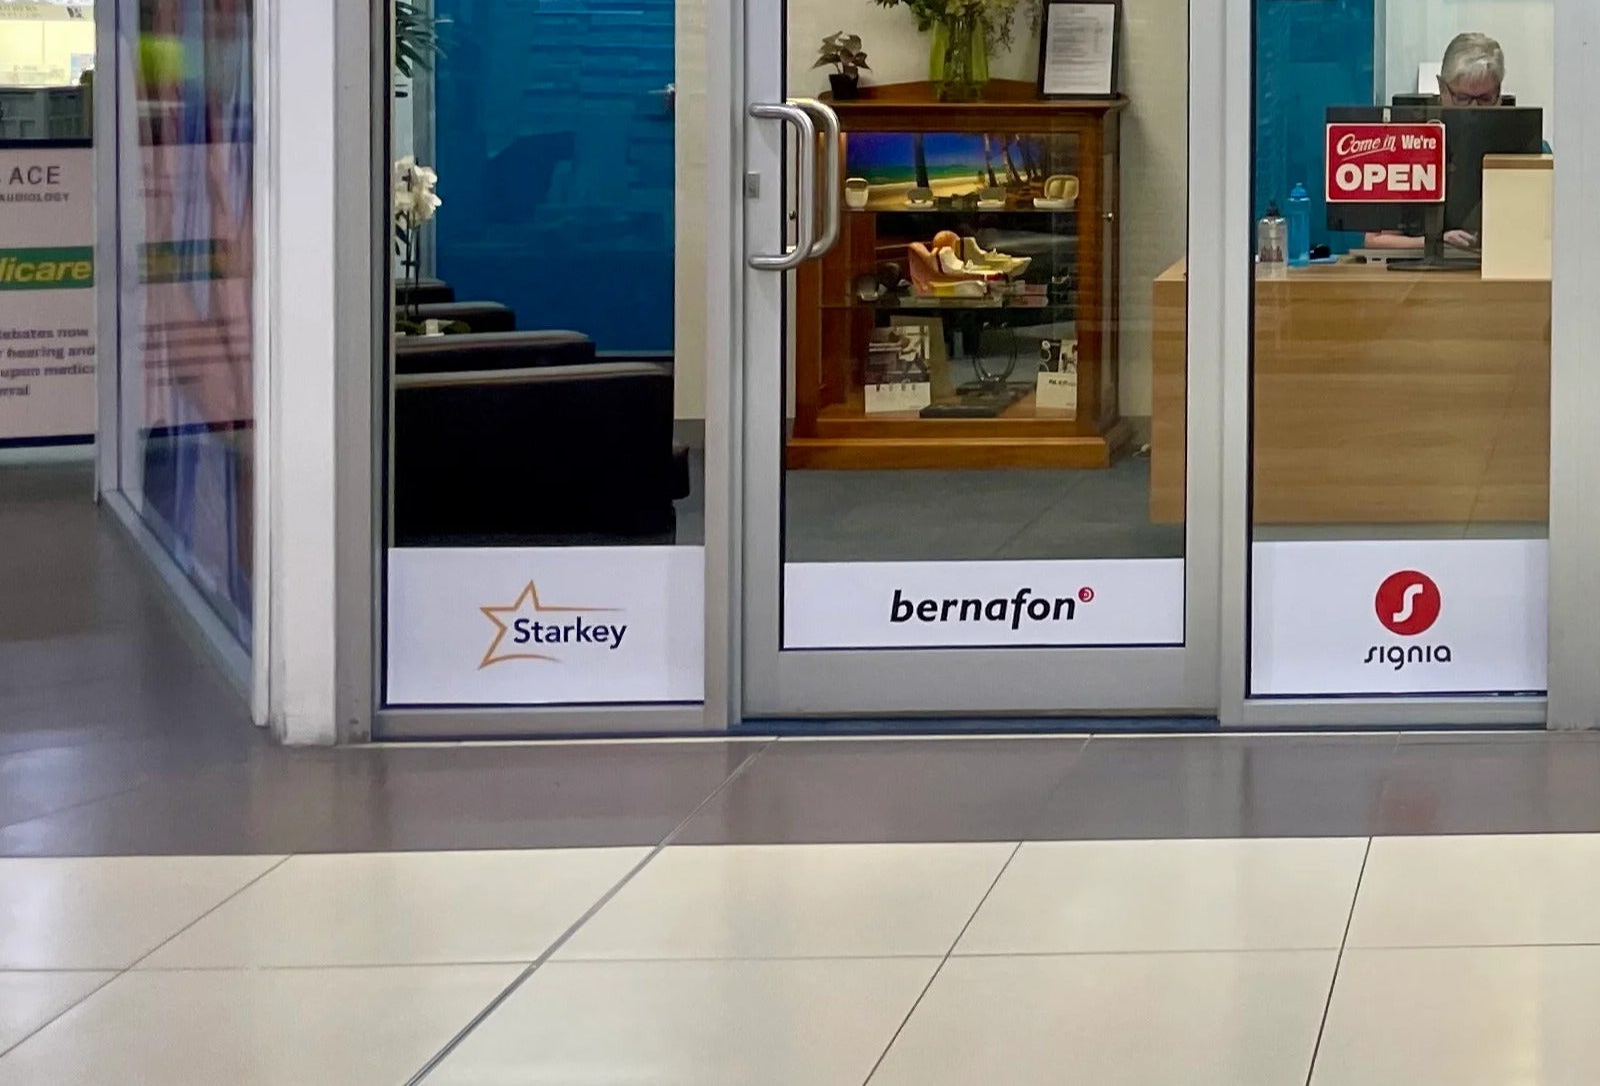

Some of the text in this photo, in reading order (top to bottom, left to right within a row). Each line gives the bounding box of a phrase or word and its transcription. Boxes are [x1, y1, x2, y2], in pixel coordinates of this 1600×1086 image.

[1336, 133, 1436, 156] Come in We're
[9, 166, 60, 185] ACE
[1335, 163, 1436, 191] OPEN
[890, 588, 1075, 630] bernafon
[513, 617, 627, 649] Starkey
[1364, 645, 1452, 671] signia
